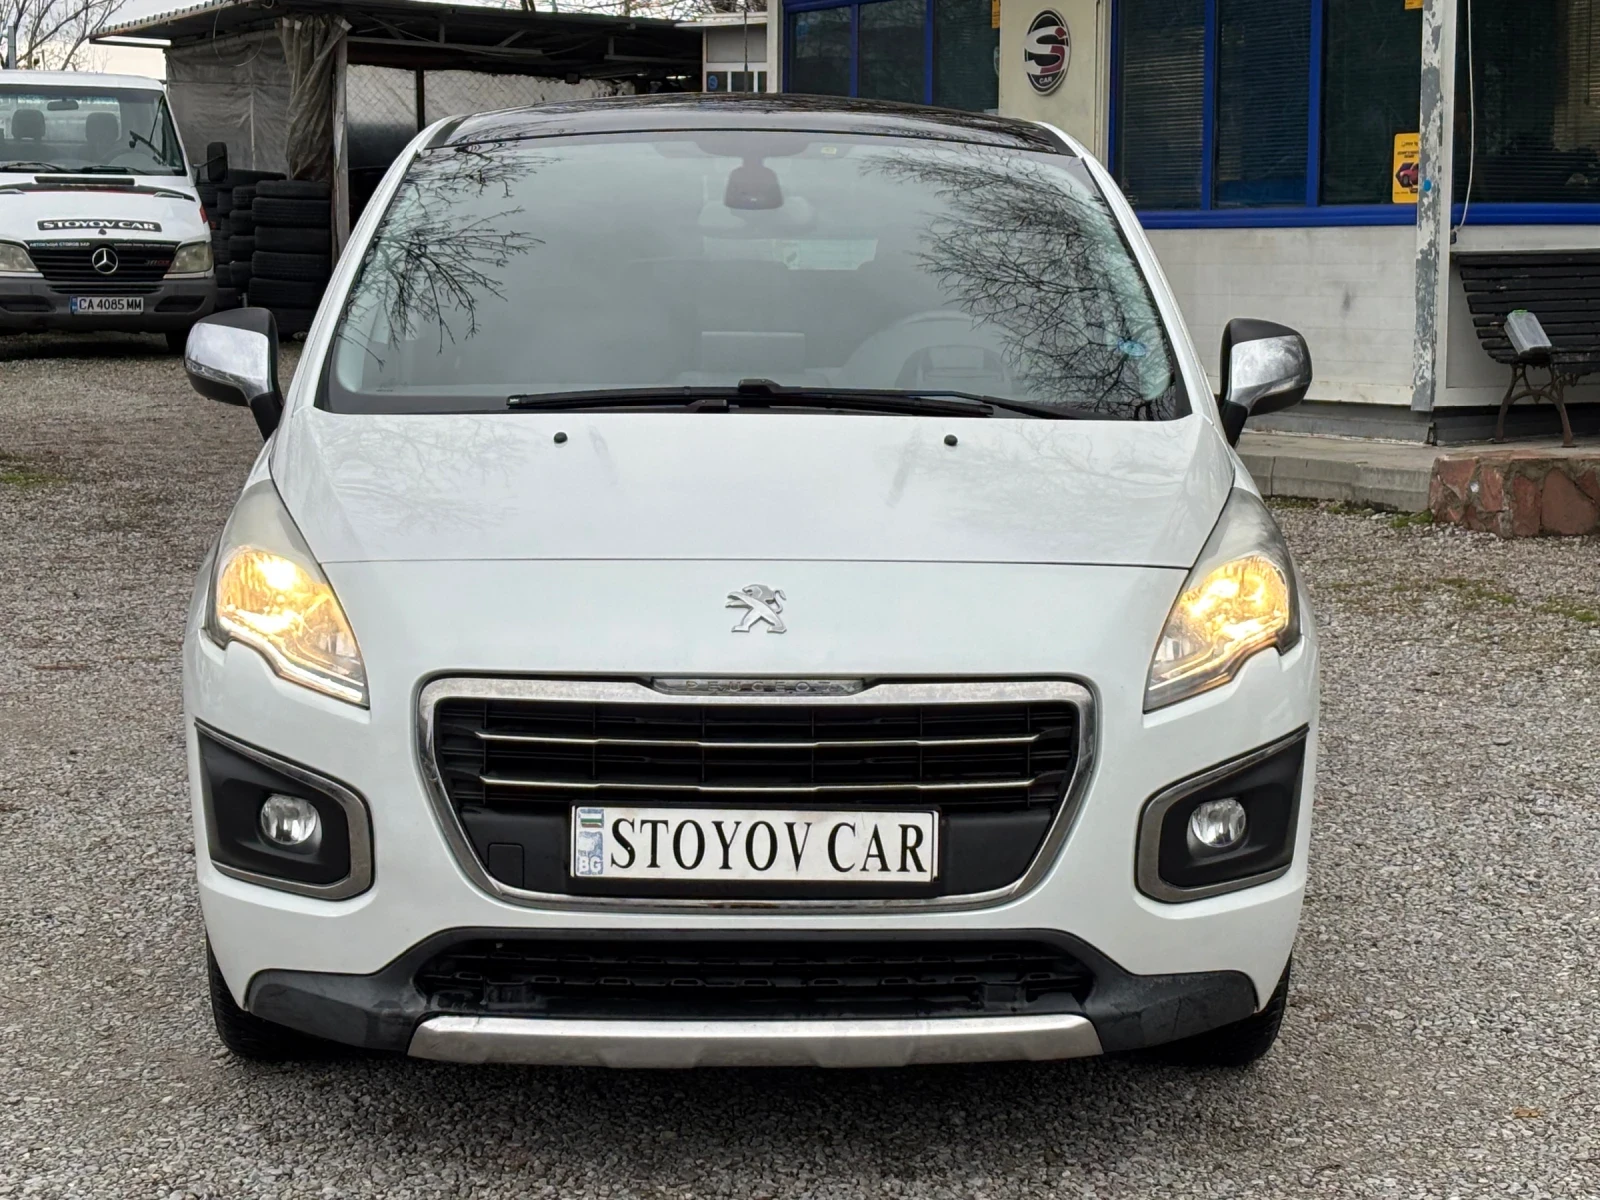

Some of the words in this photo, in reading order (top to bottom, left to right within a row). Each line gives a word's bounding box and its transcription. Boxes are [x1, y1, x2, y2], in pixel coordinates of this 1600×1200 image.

[1039, 76, 1053, 84] CAR
[43, 220, 113, 229] STOYOV
[118, 221, 156, 230] CAR
[79, 298, 94, 310] CA
[96, 298, 125, 310] 4085
[126, 298, 142, 310] MM
[685, 680, 831, 692] PEUGEOT
[611, 817, 812, 872] STOYOV
[827, 822, 927, 873] CAR
[579, 855, 602, 873] BG
